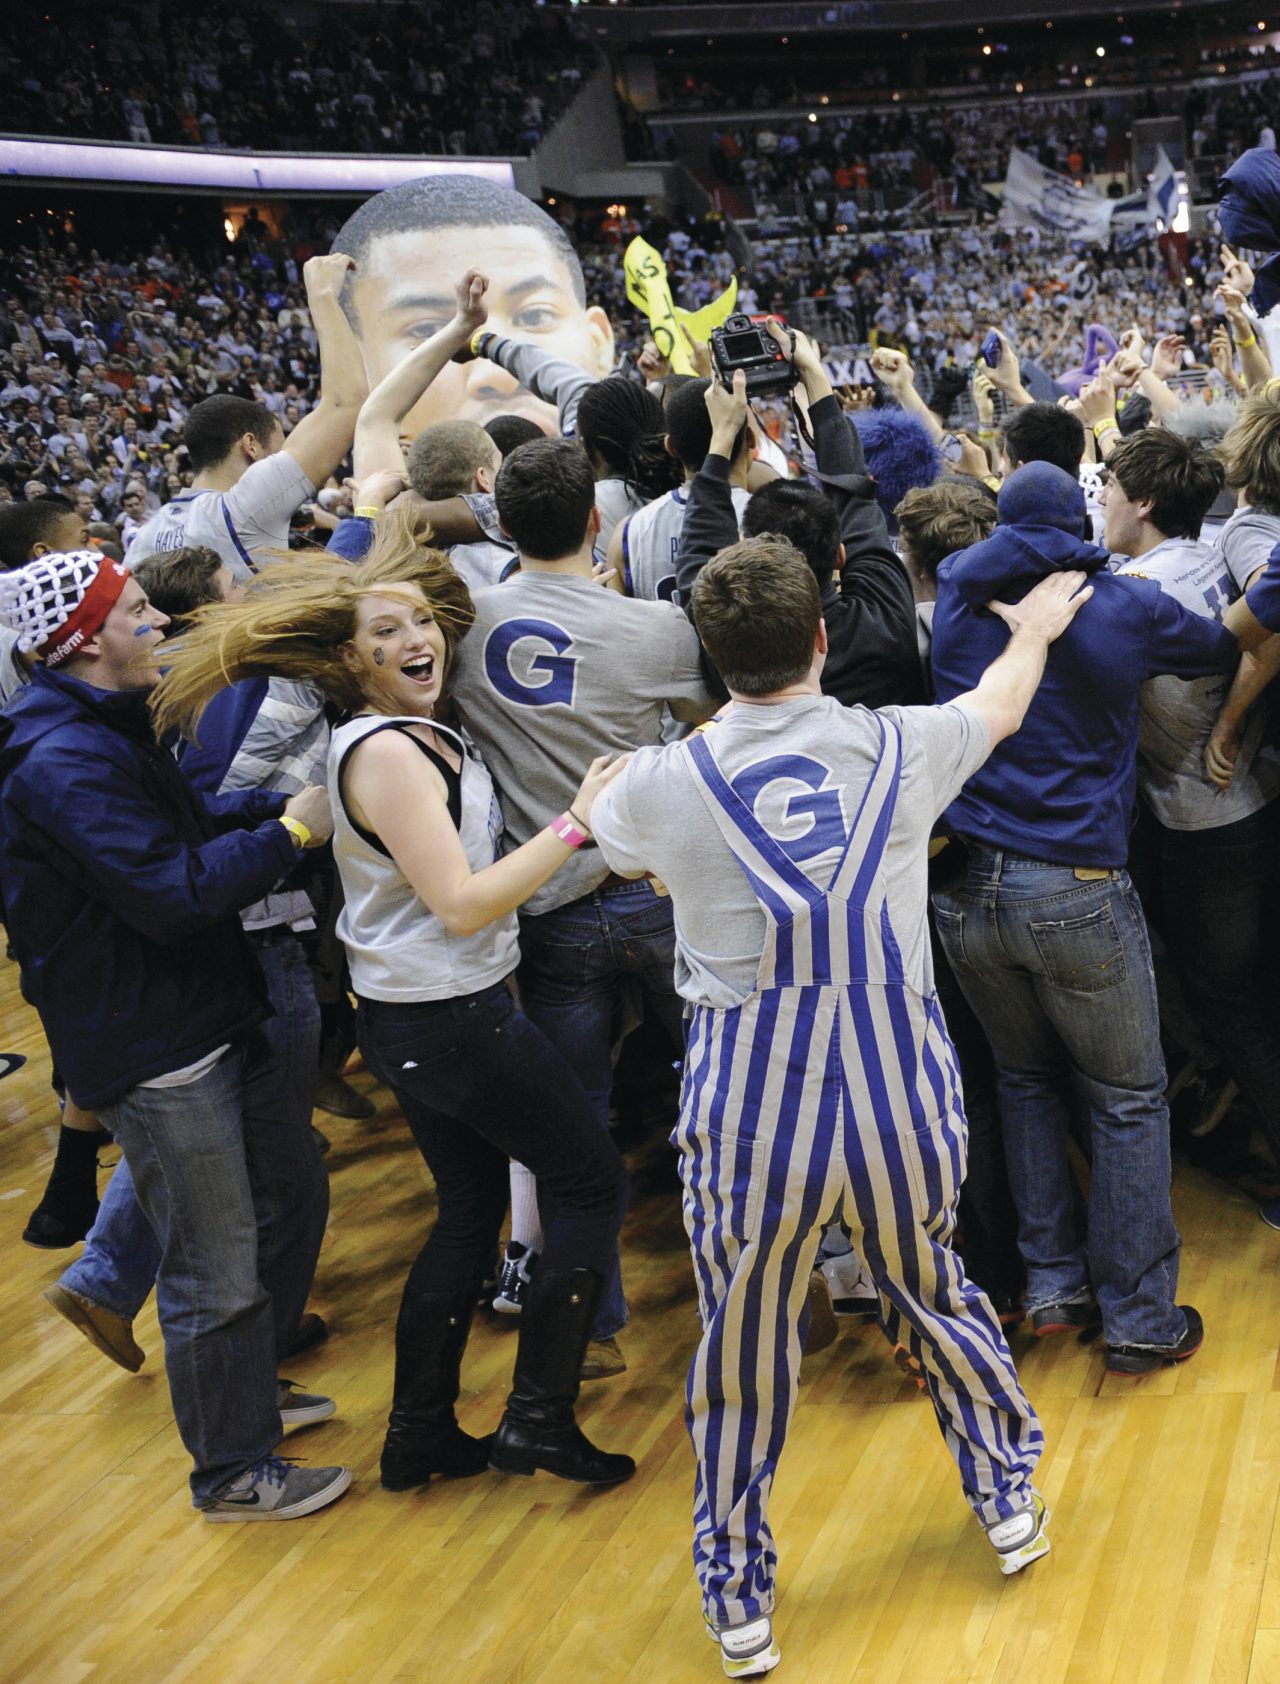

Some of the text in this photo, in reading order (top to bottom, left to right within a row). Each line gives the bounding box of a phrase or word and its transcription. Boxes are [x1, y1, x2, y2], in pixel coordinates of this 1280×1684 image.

[155, 524, 185, 553] HAYES
[482, 615, 586, 712] G
[728, 748, 848, 869] G
